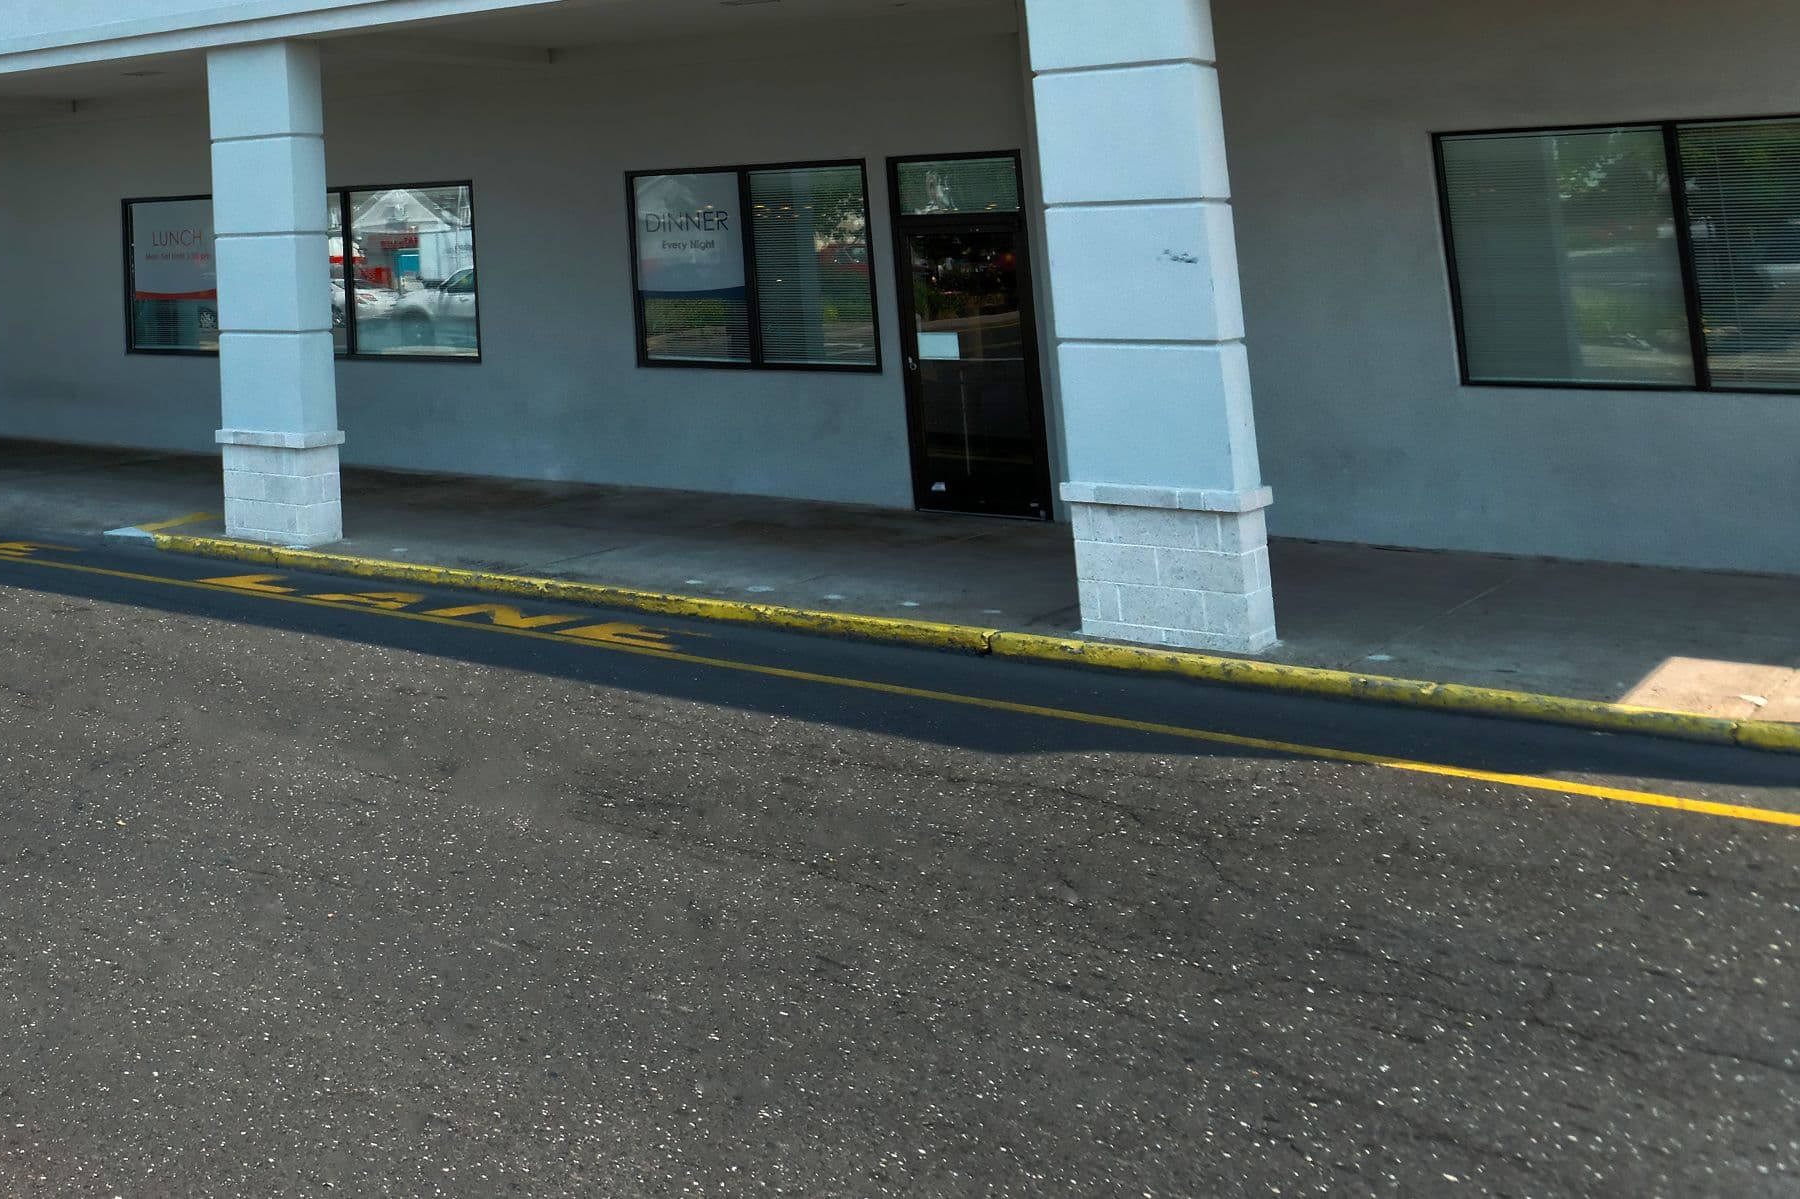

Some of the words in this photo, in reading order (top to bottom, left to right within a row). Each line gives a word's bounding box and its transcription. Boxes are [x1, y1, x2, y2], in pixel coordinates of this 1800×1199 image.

[645, 210, 729, 233] DINNER
[152, 229, 202, 248] LUNCH
[662, 239, 688, 251] Every
[690, 239, 716, 251] Night
[195, 573, 712, 651] LANE
